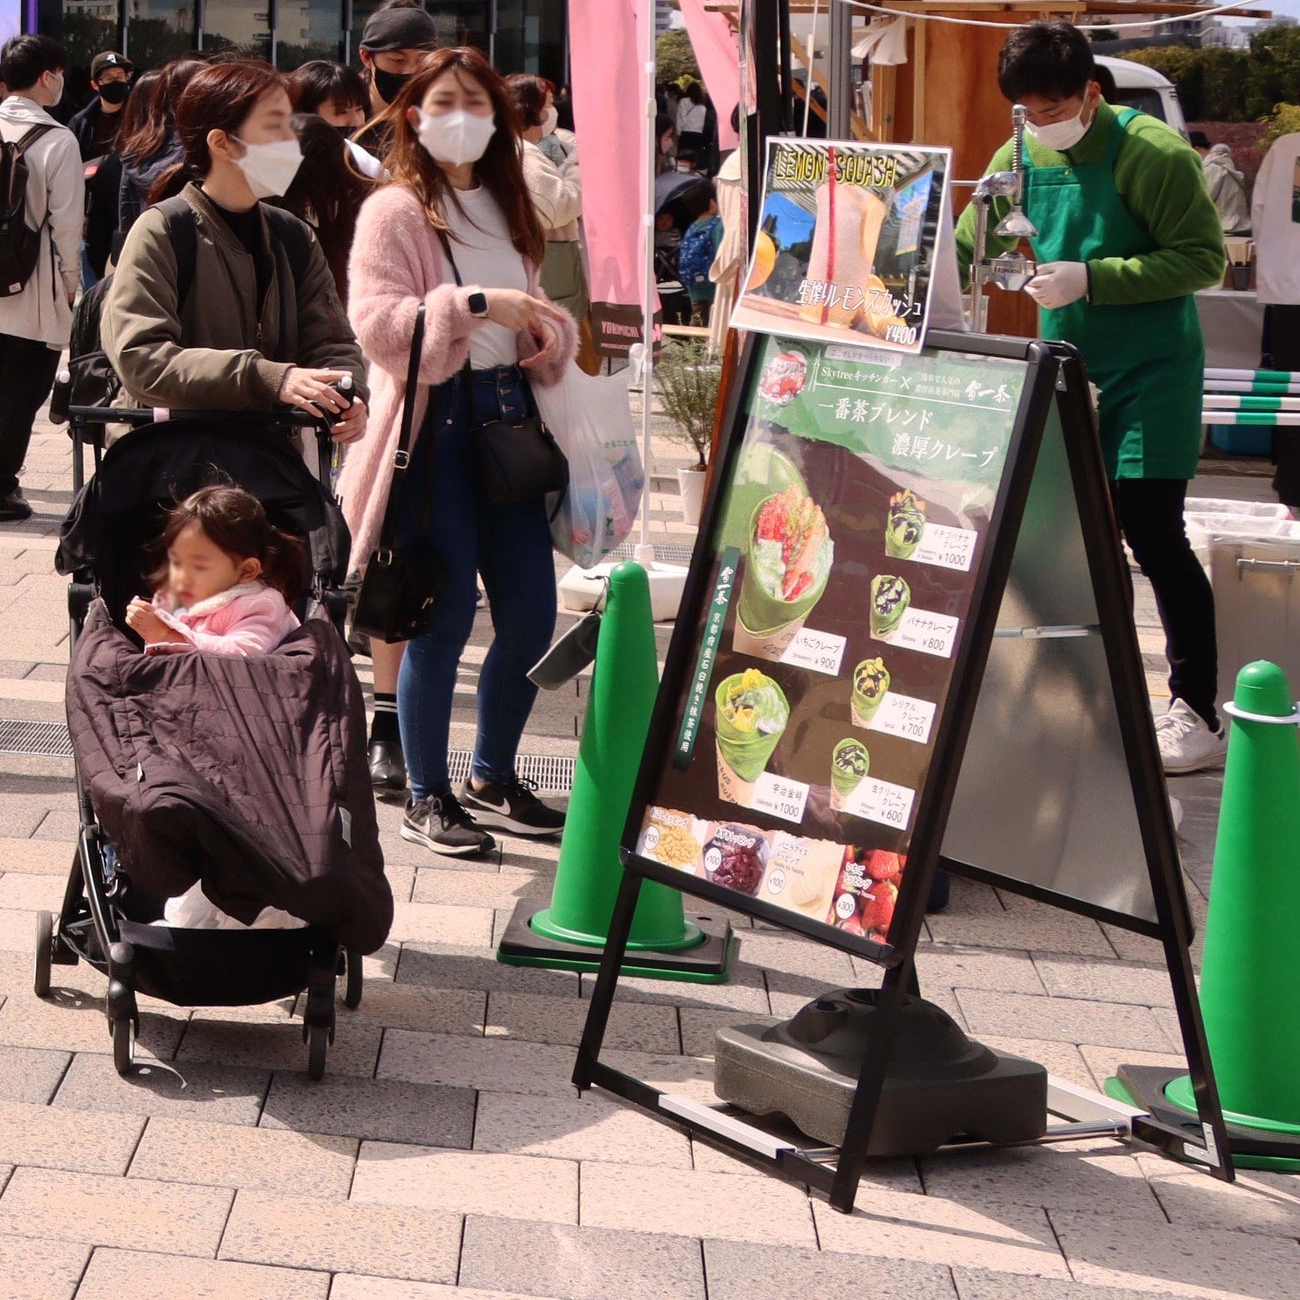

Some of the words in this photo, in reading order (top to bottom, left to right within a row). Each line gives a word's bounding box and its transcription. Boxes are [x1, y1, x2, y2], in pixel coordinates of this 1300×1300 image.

[776, 150, 827, 182] LEMON
[834, 155, 897, 187] SQUASH
[796, 279, 921, 317] 生搾りレモンスカッシュ
[885, 325, 917, 345] ¥400
[818, 397, 933, 431] 一番茶ブレンド
[892, 432, 999, 467] 濃厚クレープ
[796, 636, 840, 654] いちごクレープ
